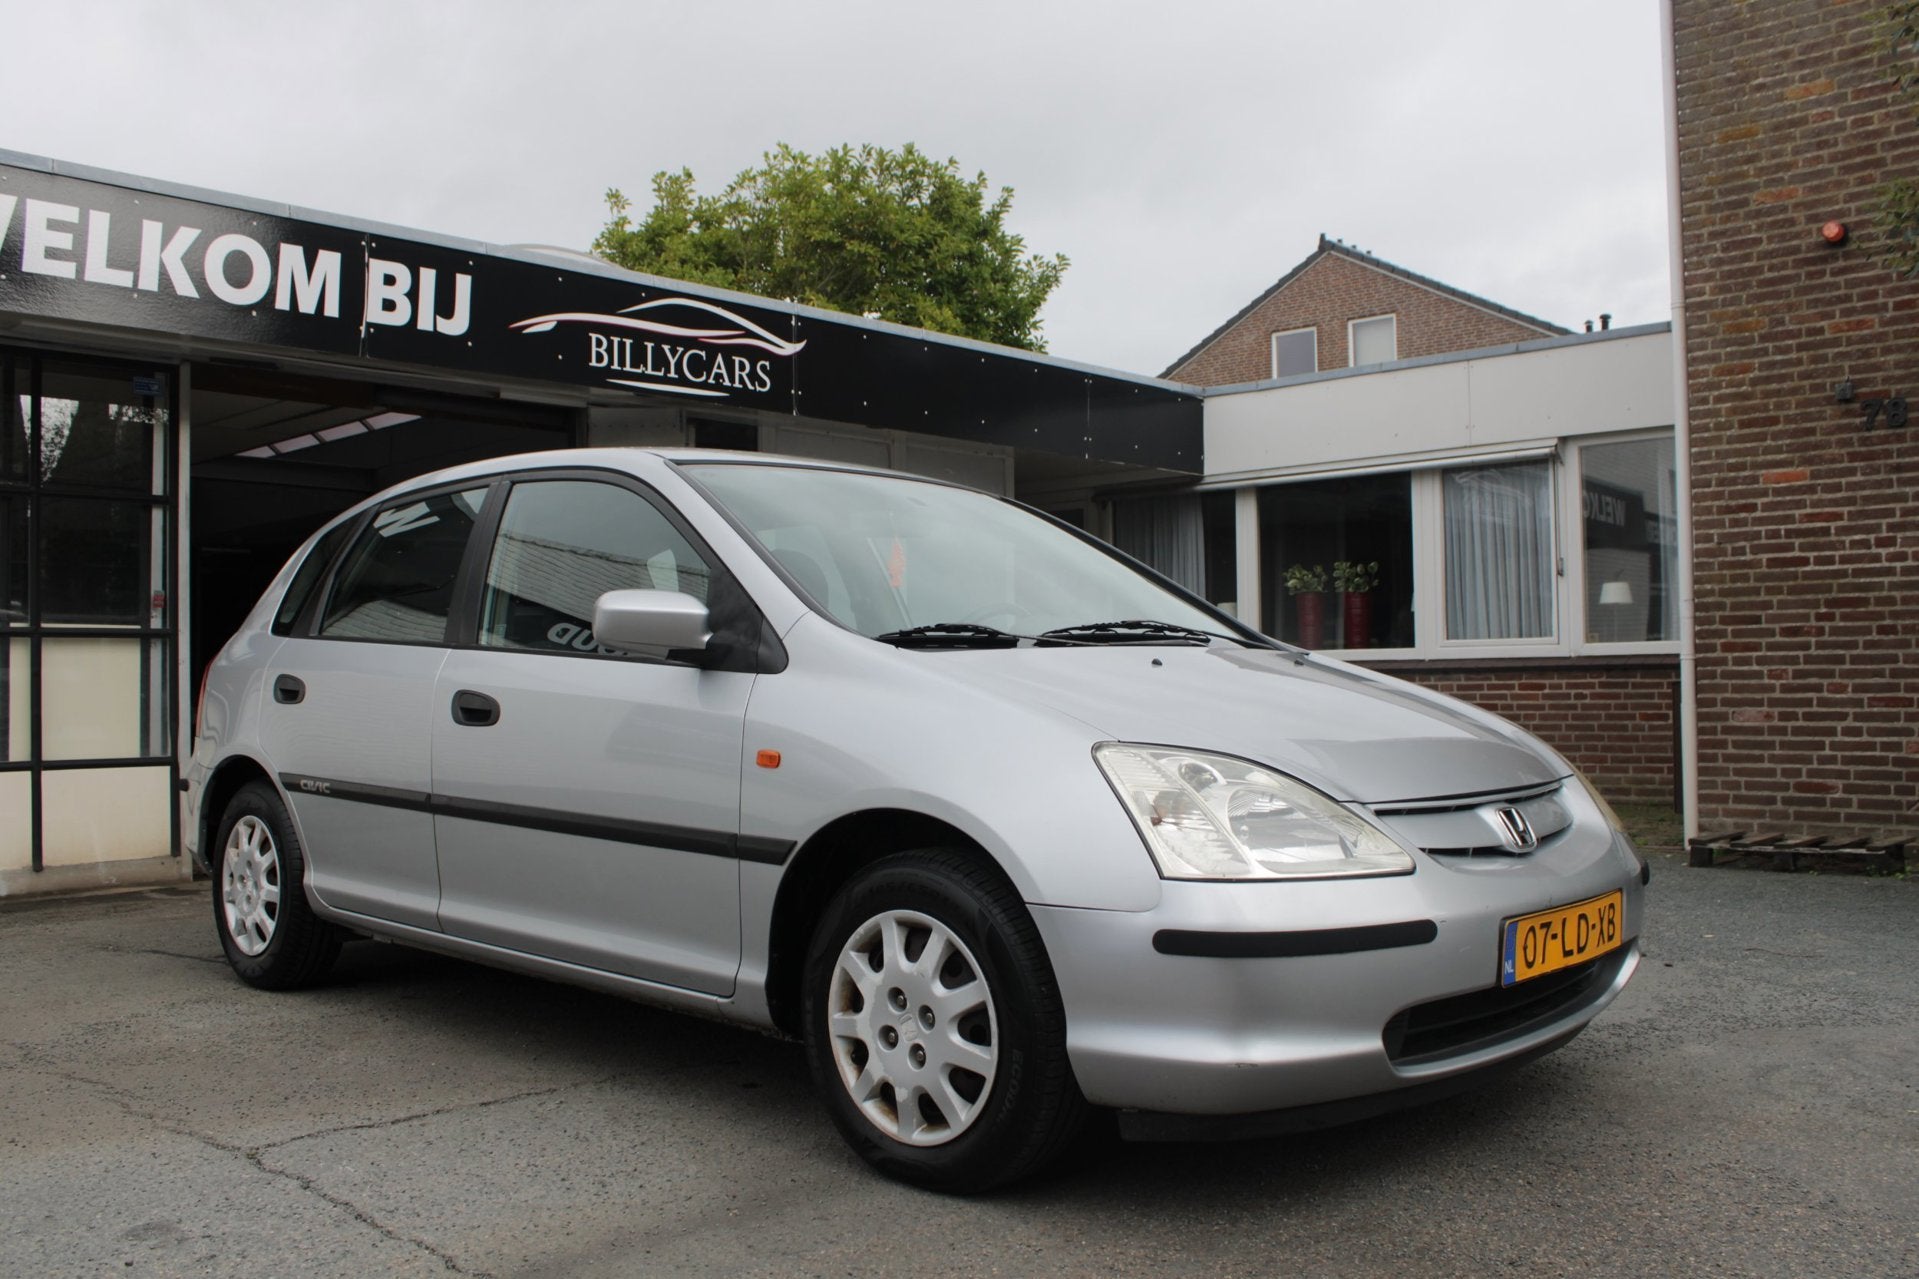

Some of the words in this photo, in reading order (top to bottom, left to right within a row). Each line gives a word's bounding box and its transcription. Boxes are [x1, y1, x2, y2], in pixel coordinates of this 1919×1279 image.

[0, 192, 342, 319] ELKOM
[366, 258, 473, 336] BIJ
[588, 332, 771, 392] BILLYCARS
[1861, 397, 1907, 431] 78
[300, 779, 331, 794] CIVIC
[1523, 902, 1616, 969] 07-LD-XB
[1504, 960, 1514, 974] NL
